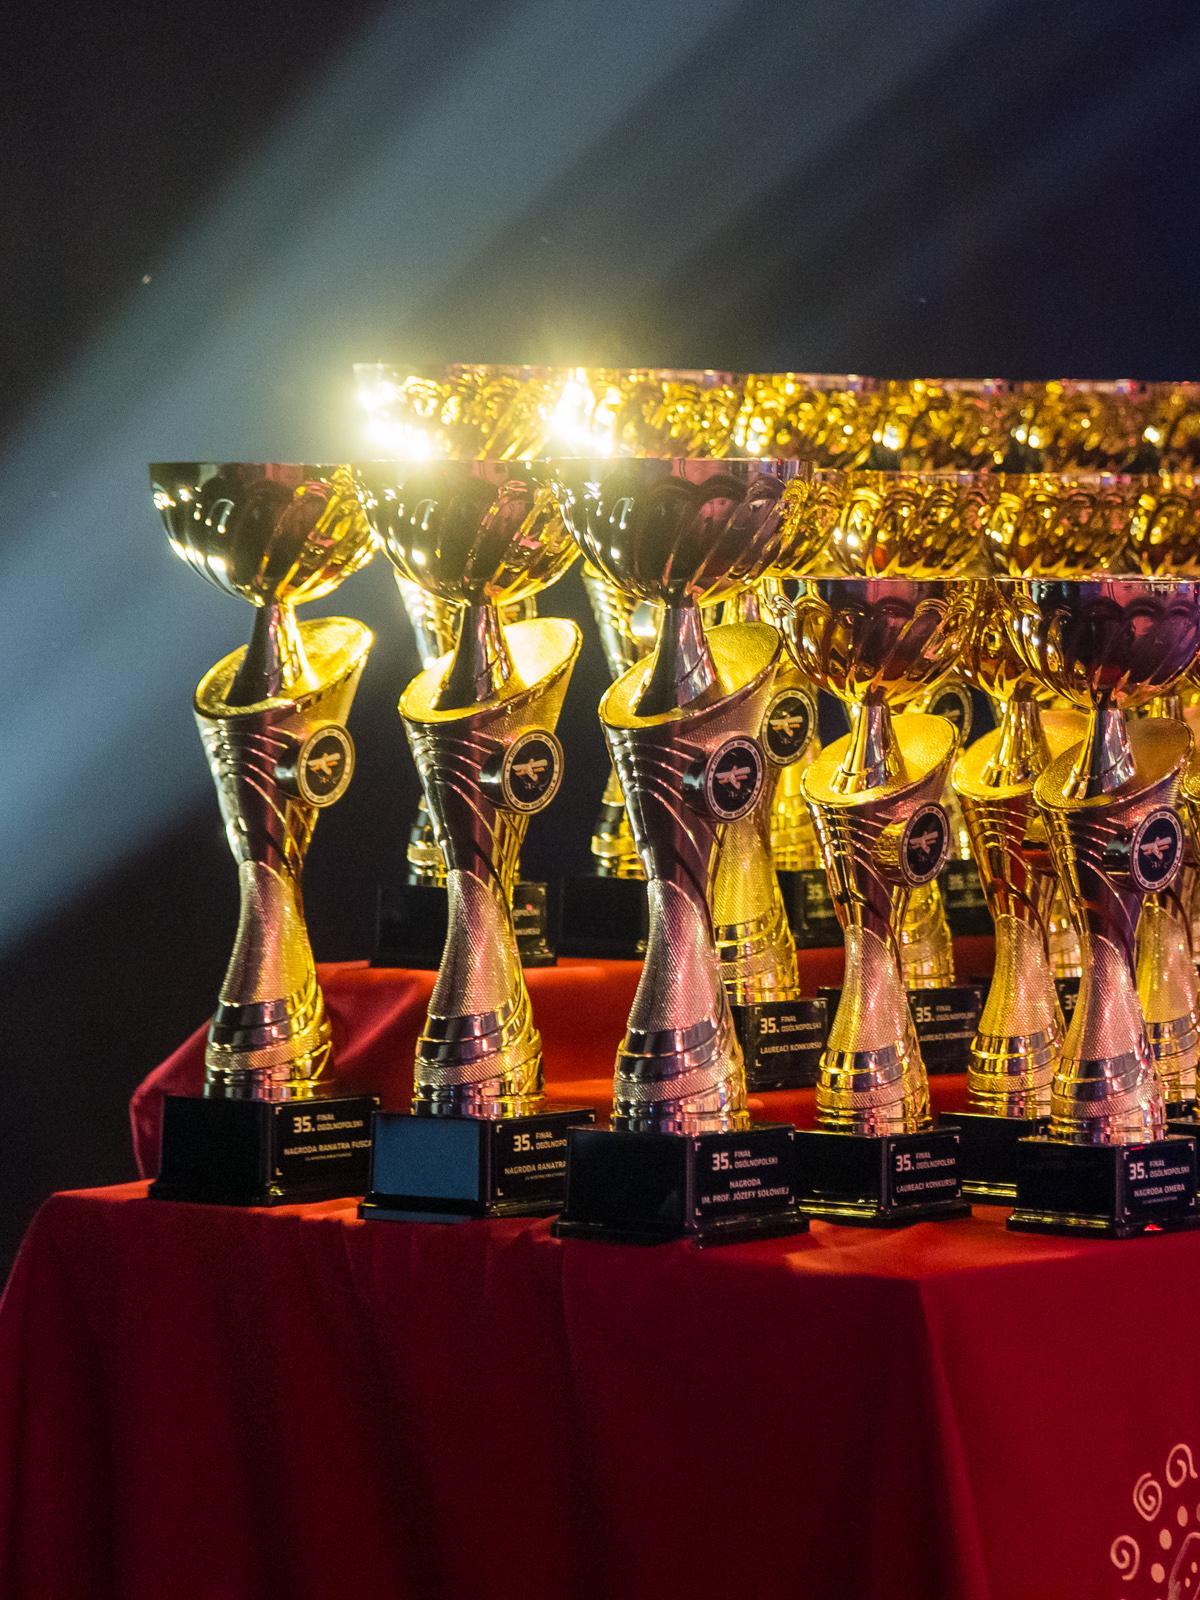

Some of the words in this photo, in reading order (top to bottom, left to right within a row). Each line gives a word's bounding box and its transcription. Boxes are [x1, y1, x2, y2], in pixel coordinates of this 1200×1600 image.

[915, 1006, 935, 1022] 35.
[760, 1017, 780, 1034] 35.
[760, 1044, 789, 1055] LAUREACI
[293, 1115, 316, 1134] 35.
[512, 1133, 535, 1152] 35.
[711, 1151, 733, 1172] 35.
[895, 1153, 915, 1172] 35.
[1129, 1162, 1149, 1181] 35.
[729, 1178, 761, 1189] NAGRODA
[1134, 1187, 1163, 1198] NAGRODA
[1164, 1183, 1185, 1193] OMERA
